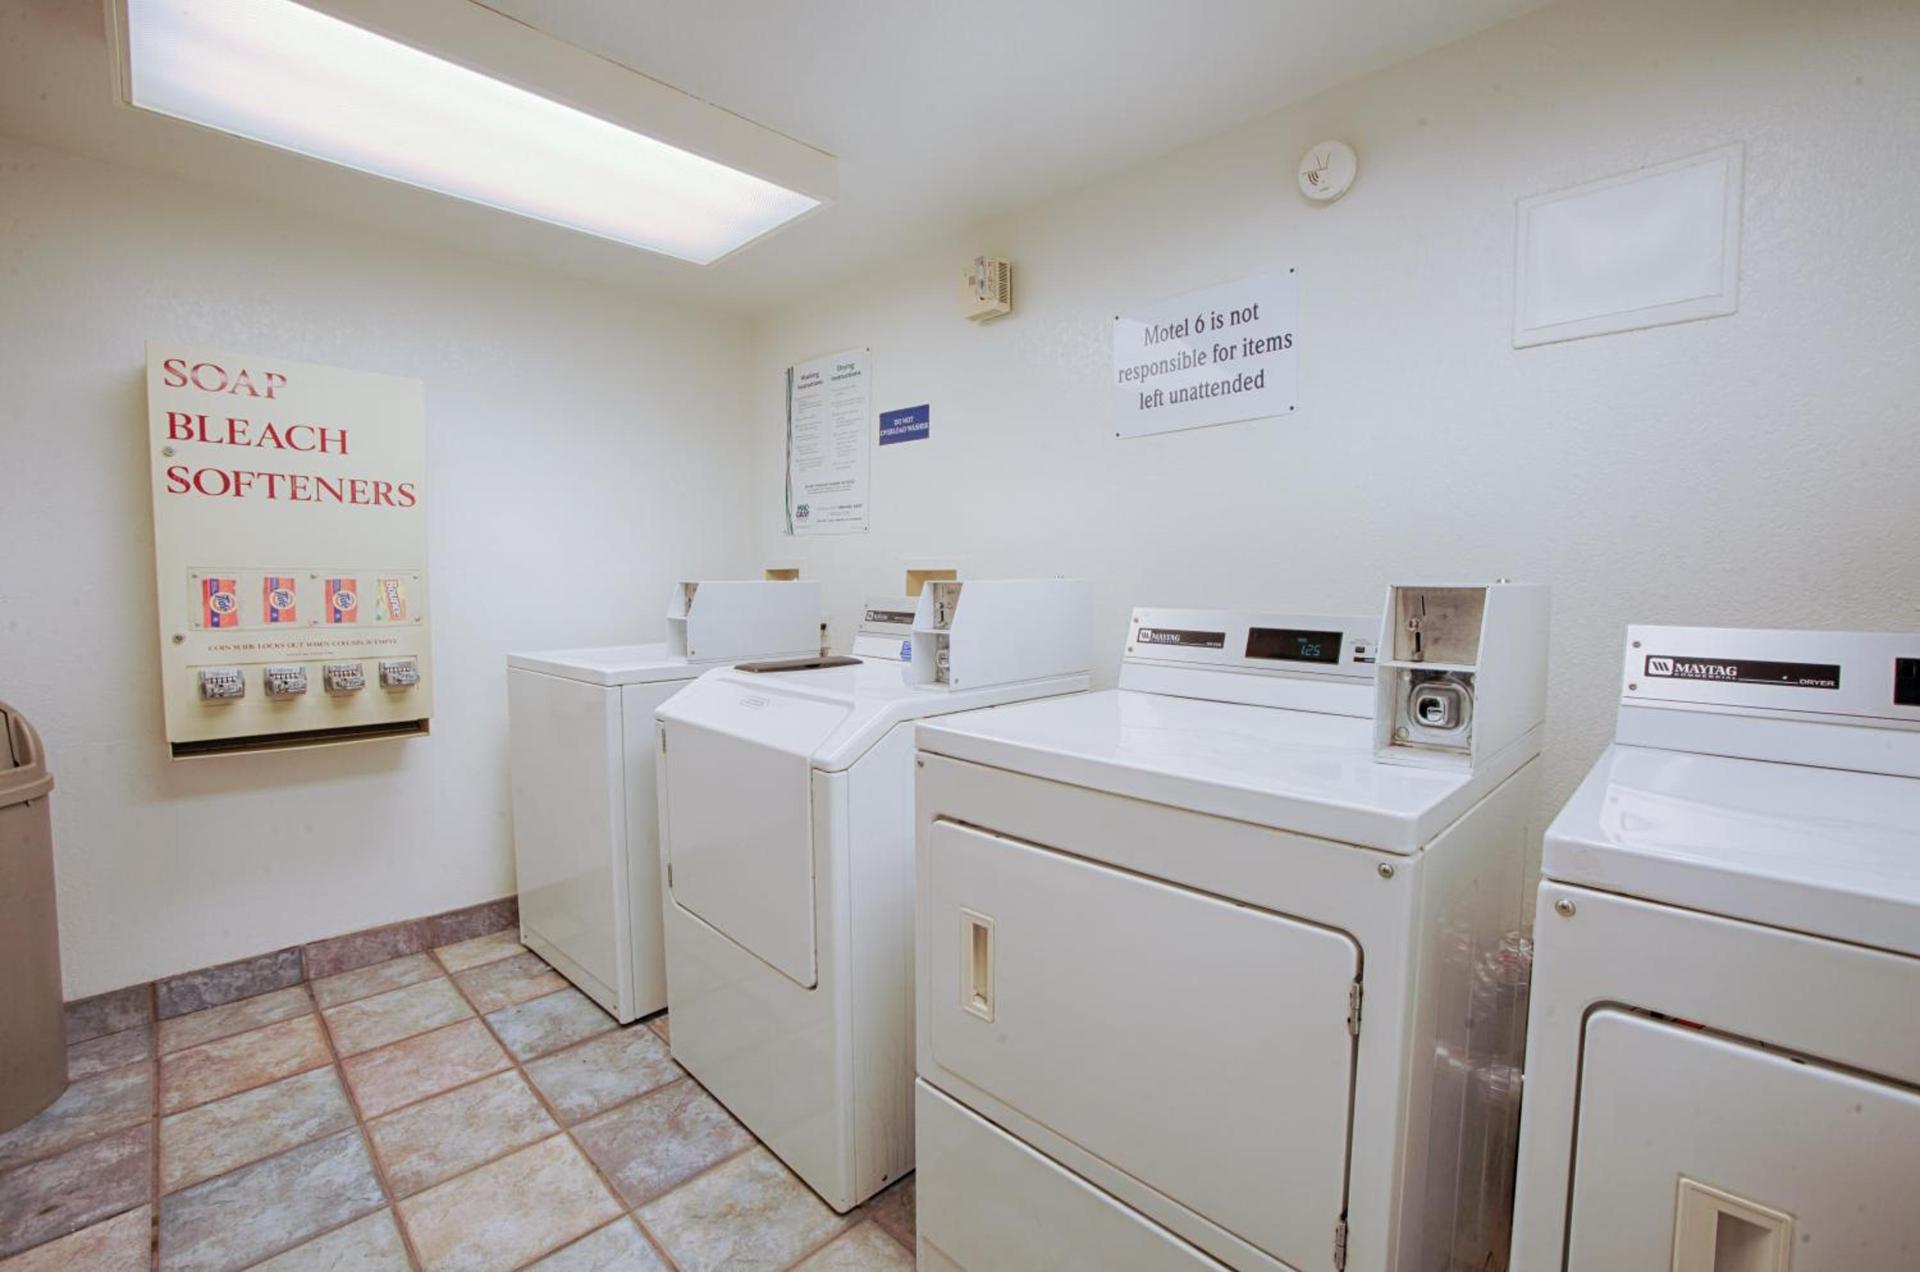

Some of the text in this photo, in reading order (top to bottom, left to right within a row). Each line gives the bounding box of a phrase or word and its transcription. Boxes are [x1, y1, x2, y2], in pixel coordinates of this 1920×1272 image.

[1144, 302, 1259, 346] Motel 6 is not
[163, 358, 287, 400] SOAP
[1118, 332, 1293, 384] responsible for items
[1139, 368, 1265, 410] left unattended
[166, 411, 349, 455] BLEACH
[166, 465, 416, 508] SOFTENERS
[1301, 644, 1320, 656] 125
[1674, 663, 1738, 677] MAYTAG
[1799, 679, 1835, 687] DRYER
